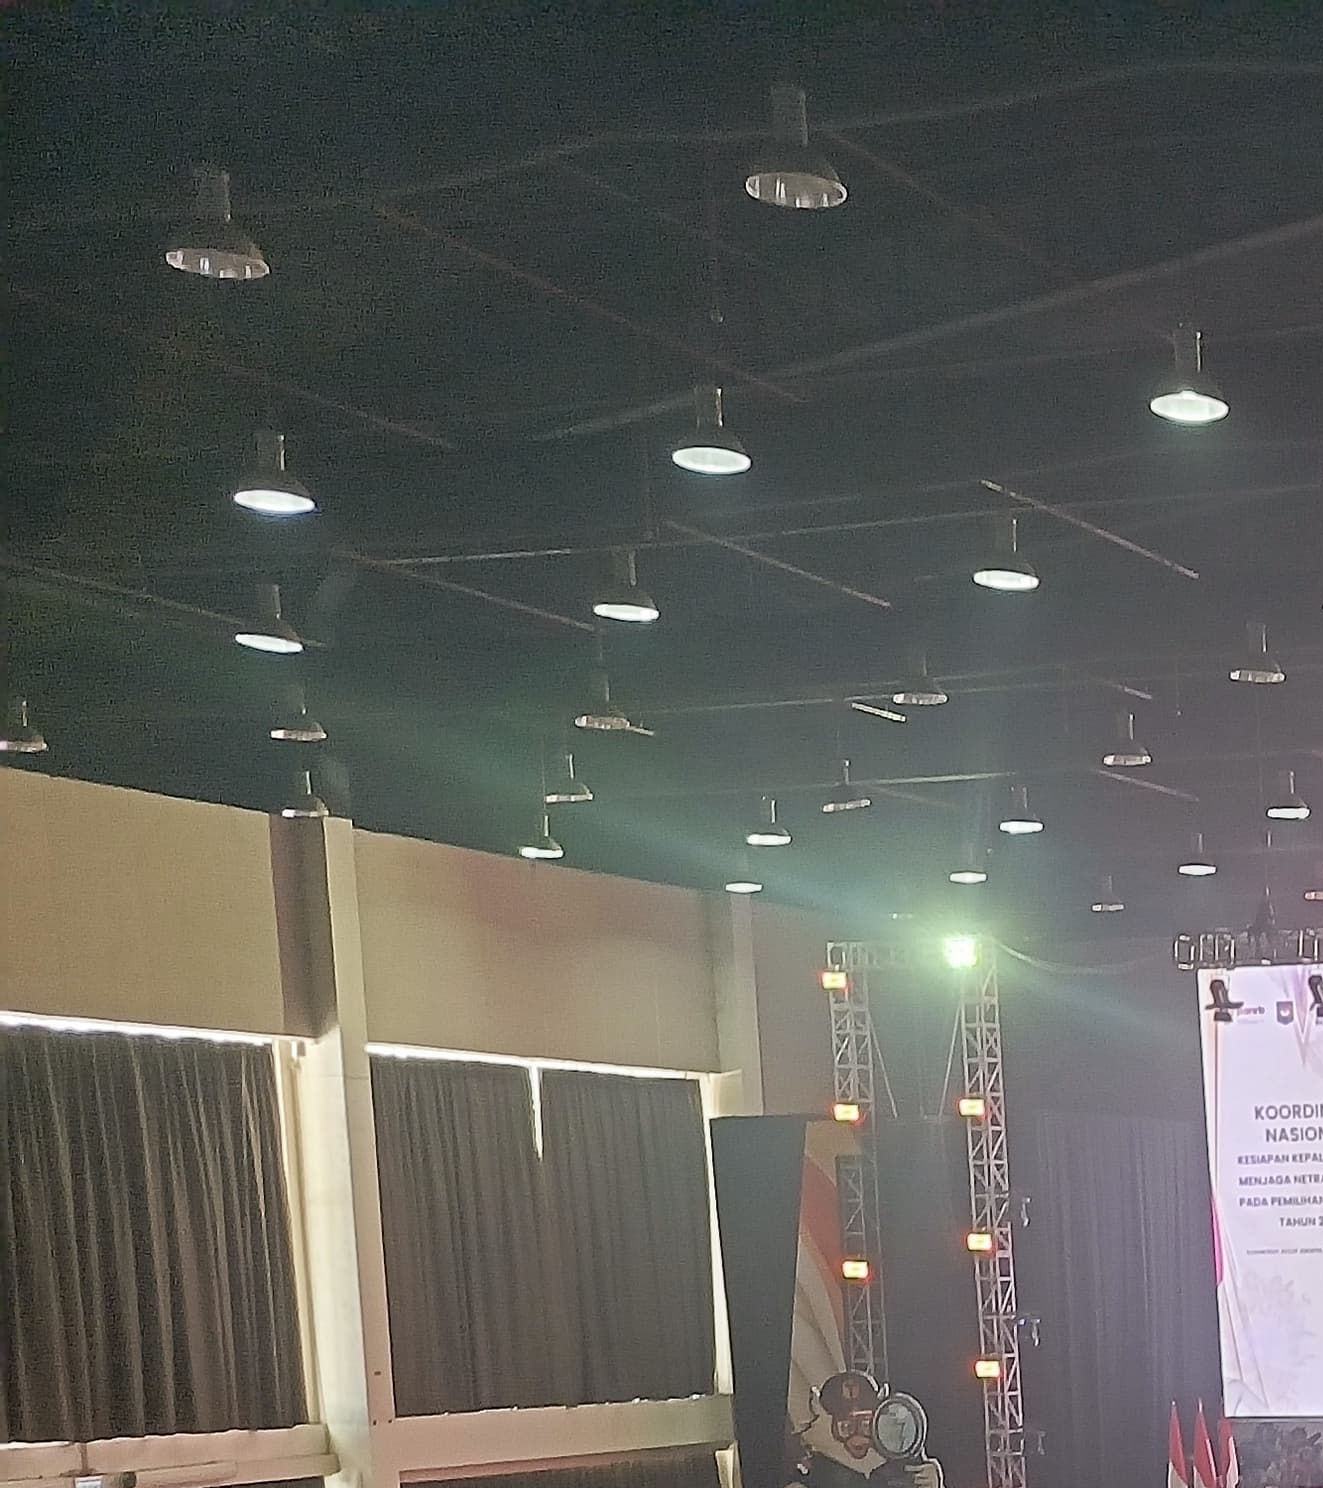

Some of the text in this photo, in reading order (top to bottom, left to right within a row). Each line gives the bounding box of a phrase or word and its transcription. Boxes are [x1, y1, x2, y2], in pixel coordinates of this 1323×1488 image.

[1237, 1153, 1289, 1165] KESIAPAN
[1238, 1175, 1291, 1186] MENJAGA
[1239, 1197, 1268, 1207] PADA
[1280, 1217, 1316, 1227] TAHUN
